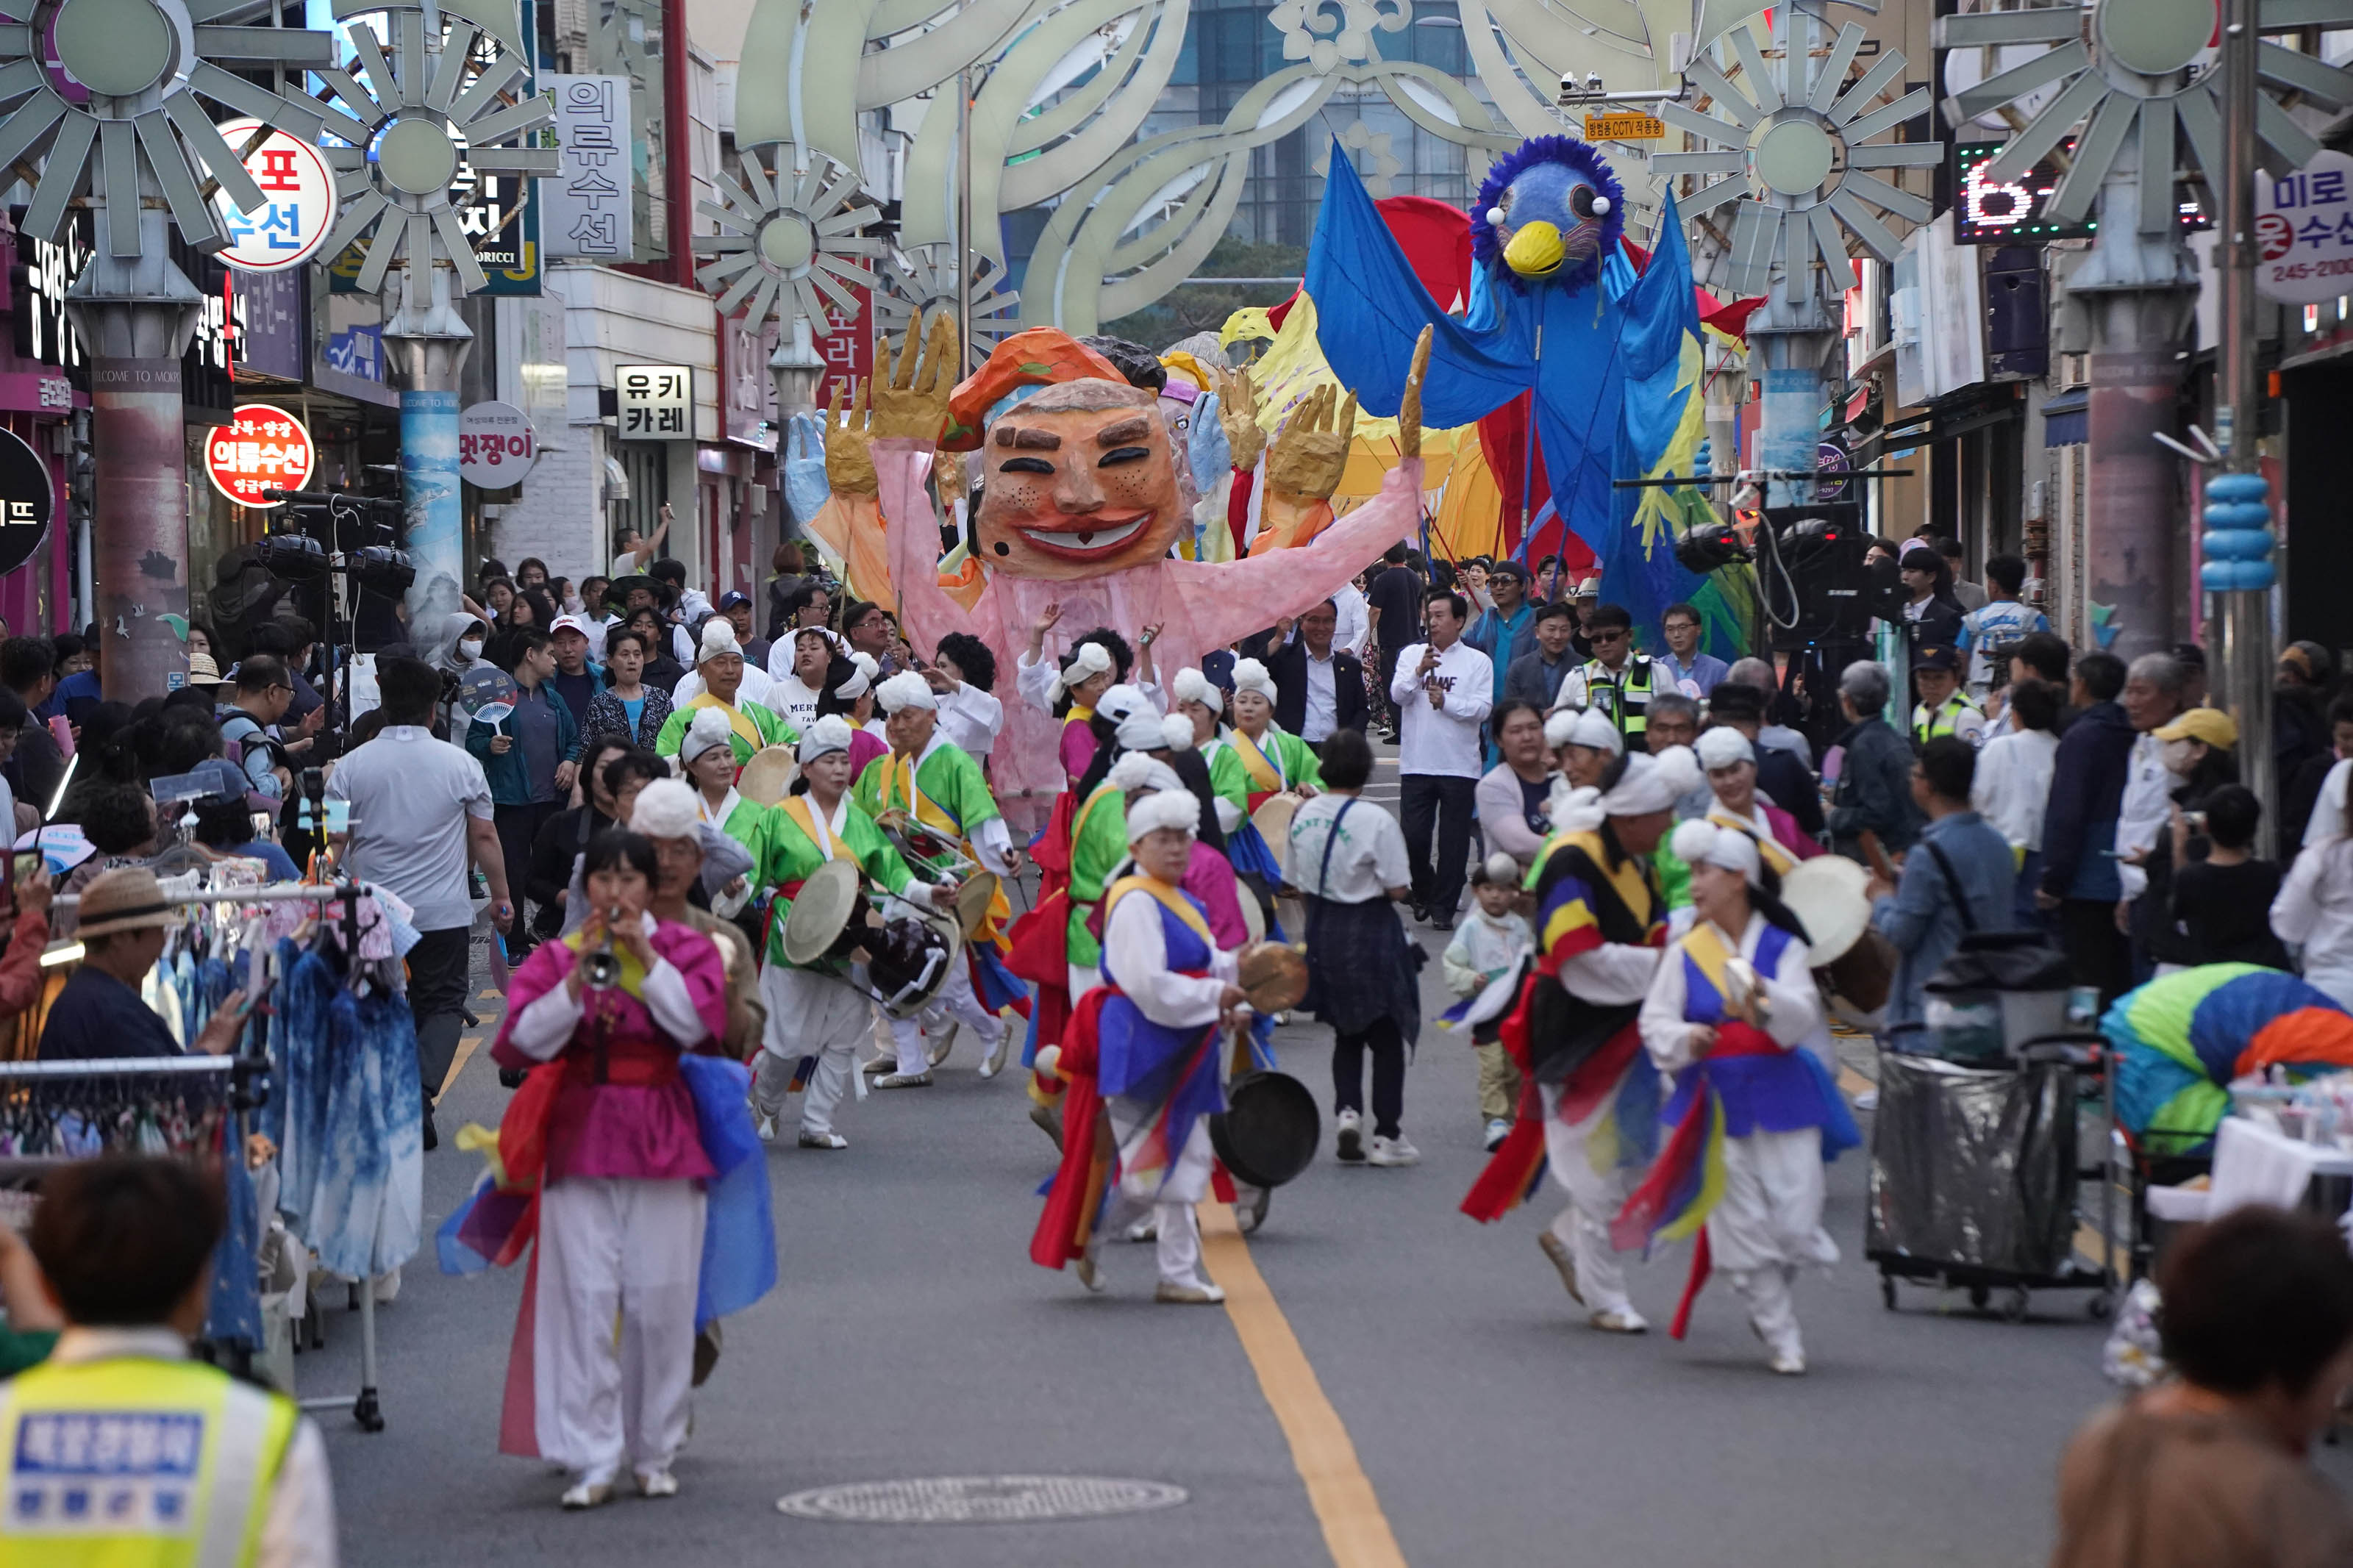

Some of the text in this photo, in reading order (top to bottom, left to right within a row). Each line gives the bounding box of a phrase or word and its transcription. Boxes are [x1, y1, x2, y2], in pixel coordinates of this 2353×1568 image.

[1590, 120, 1660, 136] 방범용 CCTV 작동중
[232, 148, 301, 191] 포
[566, 80, 619, 255] 의류수선
[2274, 171, 2347, 210] 미로
[224, 203, 301, 249] 수선
[475, 251, 515, 263] ORICCI
[135, 370, 151, 382] TO
[626, 375, 682, 399] 유키
[626, 407, 683, 432] 카레
[213, 441, 306, 475] 의류수선
[459, 428, 532, 465] 멋쟁이
